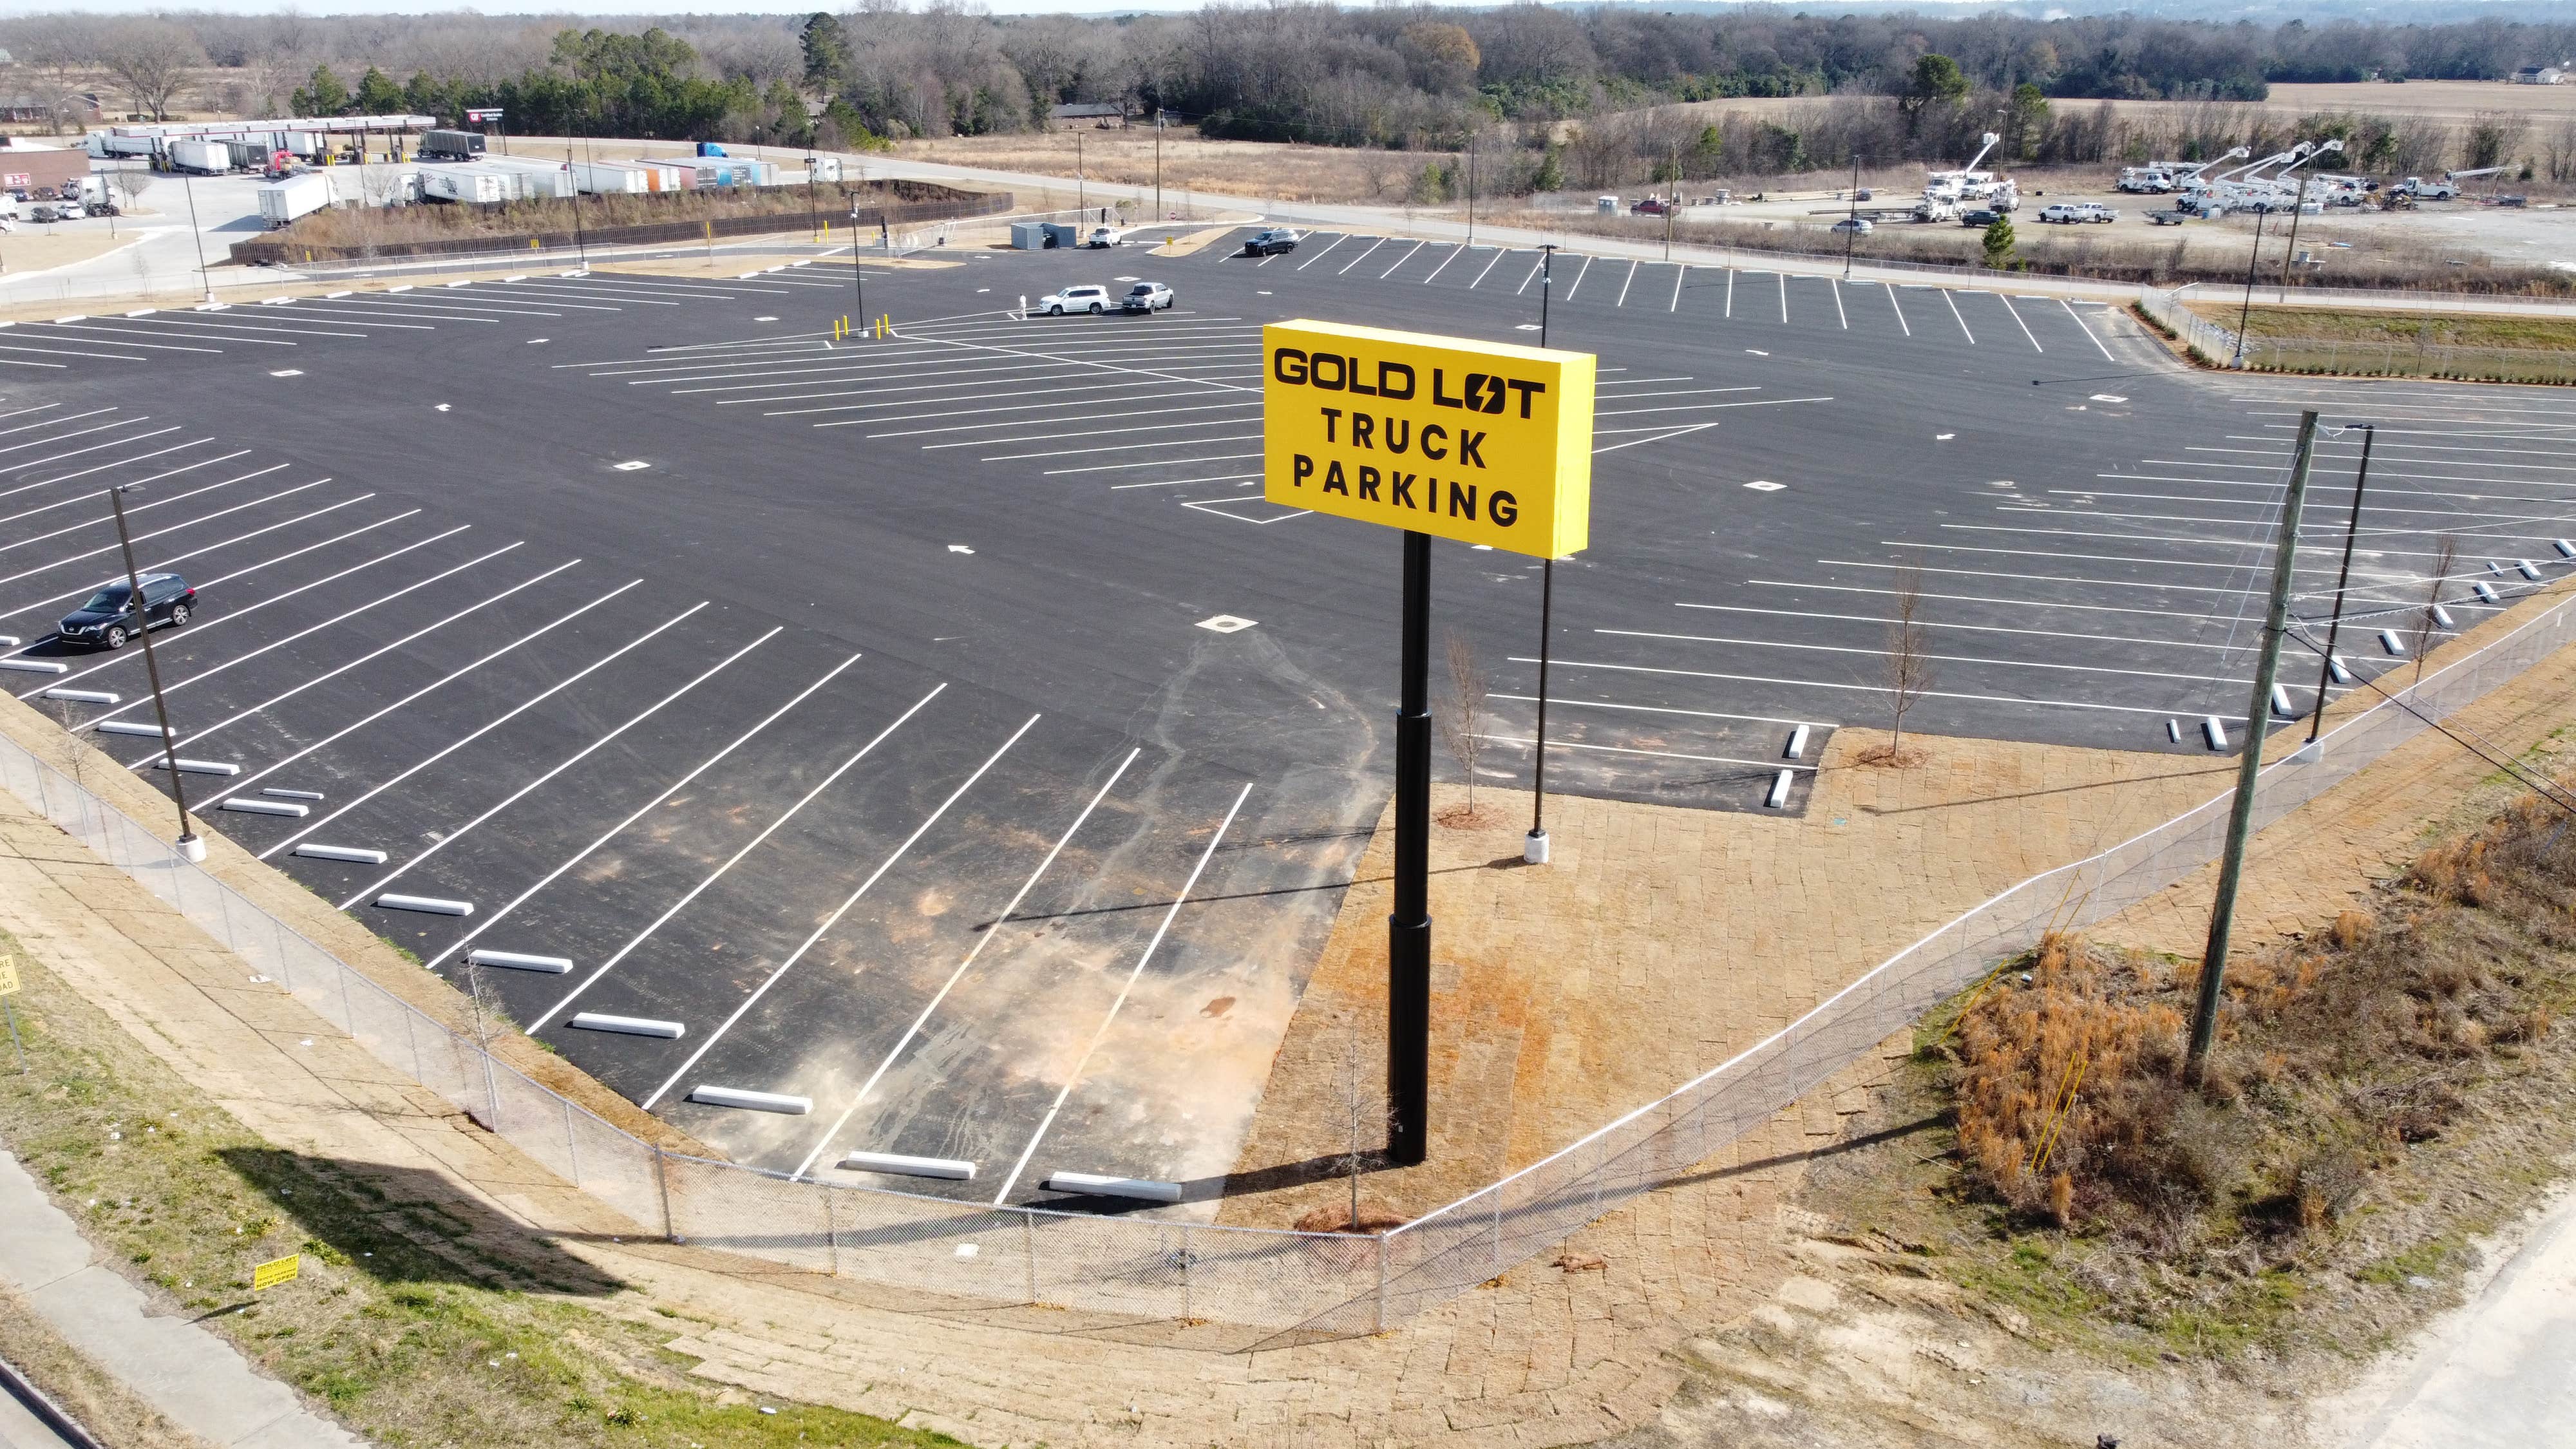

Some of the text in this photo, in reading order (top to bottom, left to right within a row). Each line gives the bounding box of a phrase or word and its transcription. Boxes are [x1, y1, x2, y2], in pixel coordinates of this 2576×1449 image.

[1274, 348, 1546, 419] GOLD LOT
[1321, 407, 1487, 469] TRUCK
[1294, 453, 1518, 527] PARKING
[256, 1280, 274, 1289] NOW
[276, 1273, 296, 1282] OPEN
